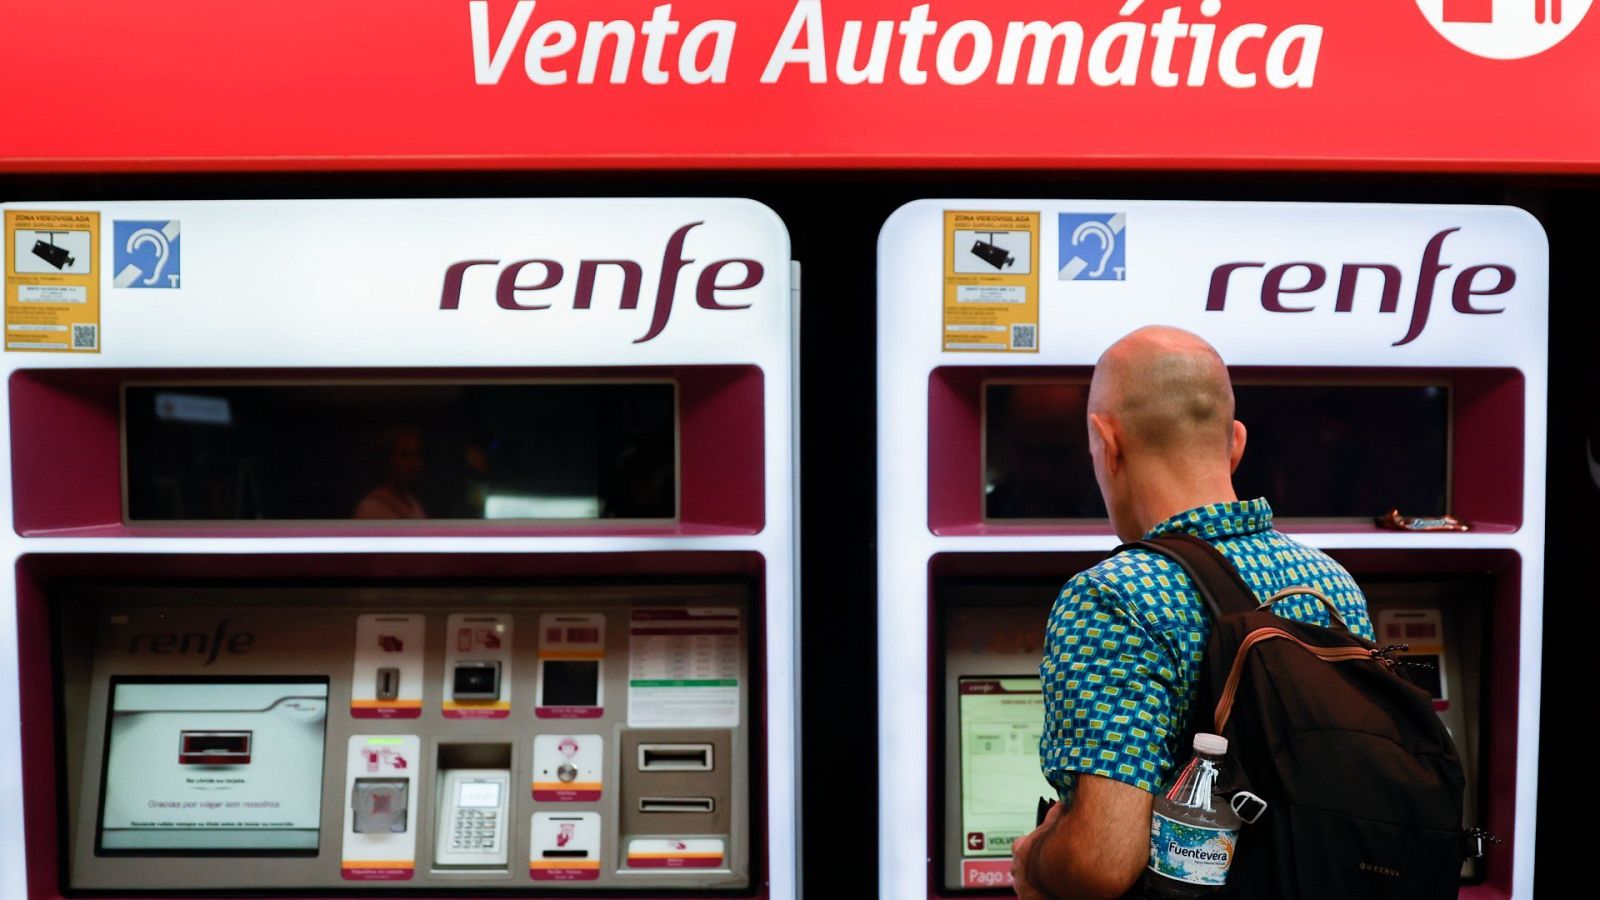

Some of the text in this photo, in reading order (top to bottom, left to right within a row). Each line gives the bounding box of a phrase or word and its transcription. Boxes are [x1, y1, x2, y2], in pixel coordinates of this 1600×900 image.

[469, 0, 1324, 89] Venta Automática
[36, 214, 90, 222] VIDEOVIGILADA
[955, 214, 1030, 222] ZONA VIDEOVIGILADA
[168, 274, 180, 288] T
[439, 221, 765, 344] renfe
[1113, 267, 1126, 280] T
[1205, 227, 1517, 347] renfe
[127, 617, 257, 667] renfe
[1168, 841, 1228, 861] Fuentevera
[969, 868, 1003, 886] Pago
